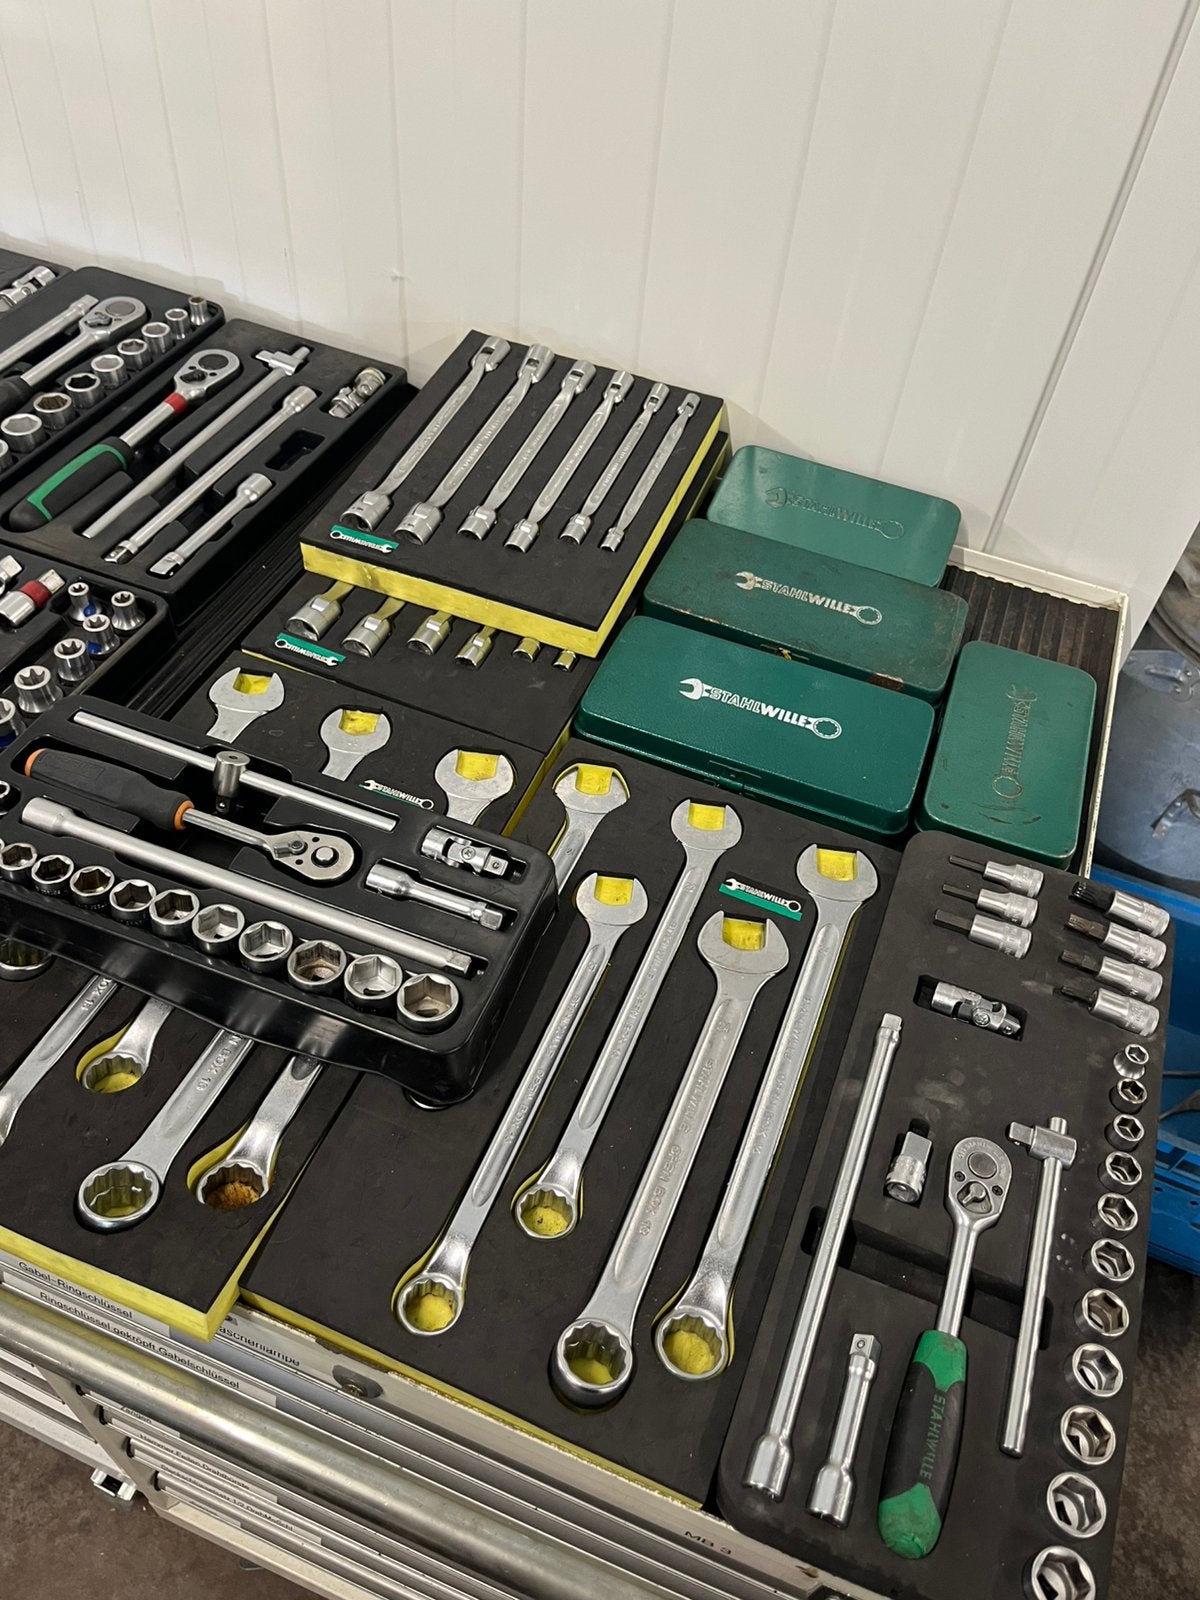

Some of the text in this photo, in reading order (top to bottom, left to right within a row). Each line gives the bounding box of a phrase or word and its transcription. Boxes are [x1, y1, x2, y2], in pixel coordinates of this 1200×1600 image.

[761, 579, 852, 614] STAHLWILLE
[709, 687, 808, 728] STAHLWILLE
[18, 1261, 133, 1319] Gabel-Ringschlüssel
[219, 1326, 301, 1367] aschenlampe
[919, 1393, 946, 1480] STAHLWILLE
